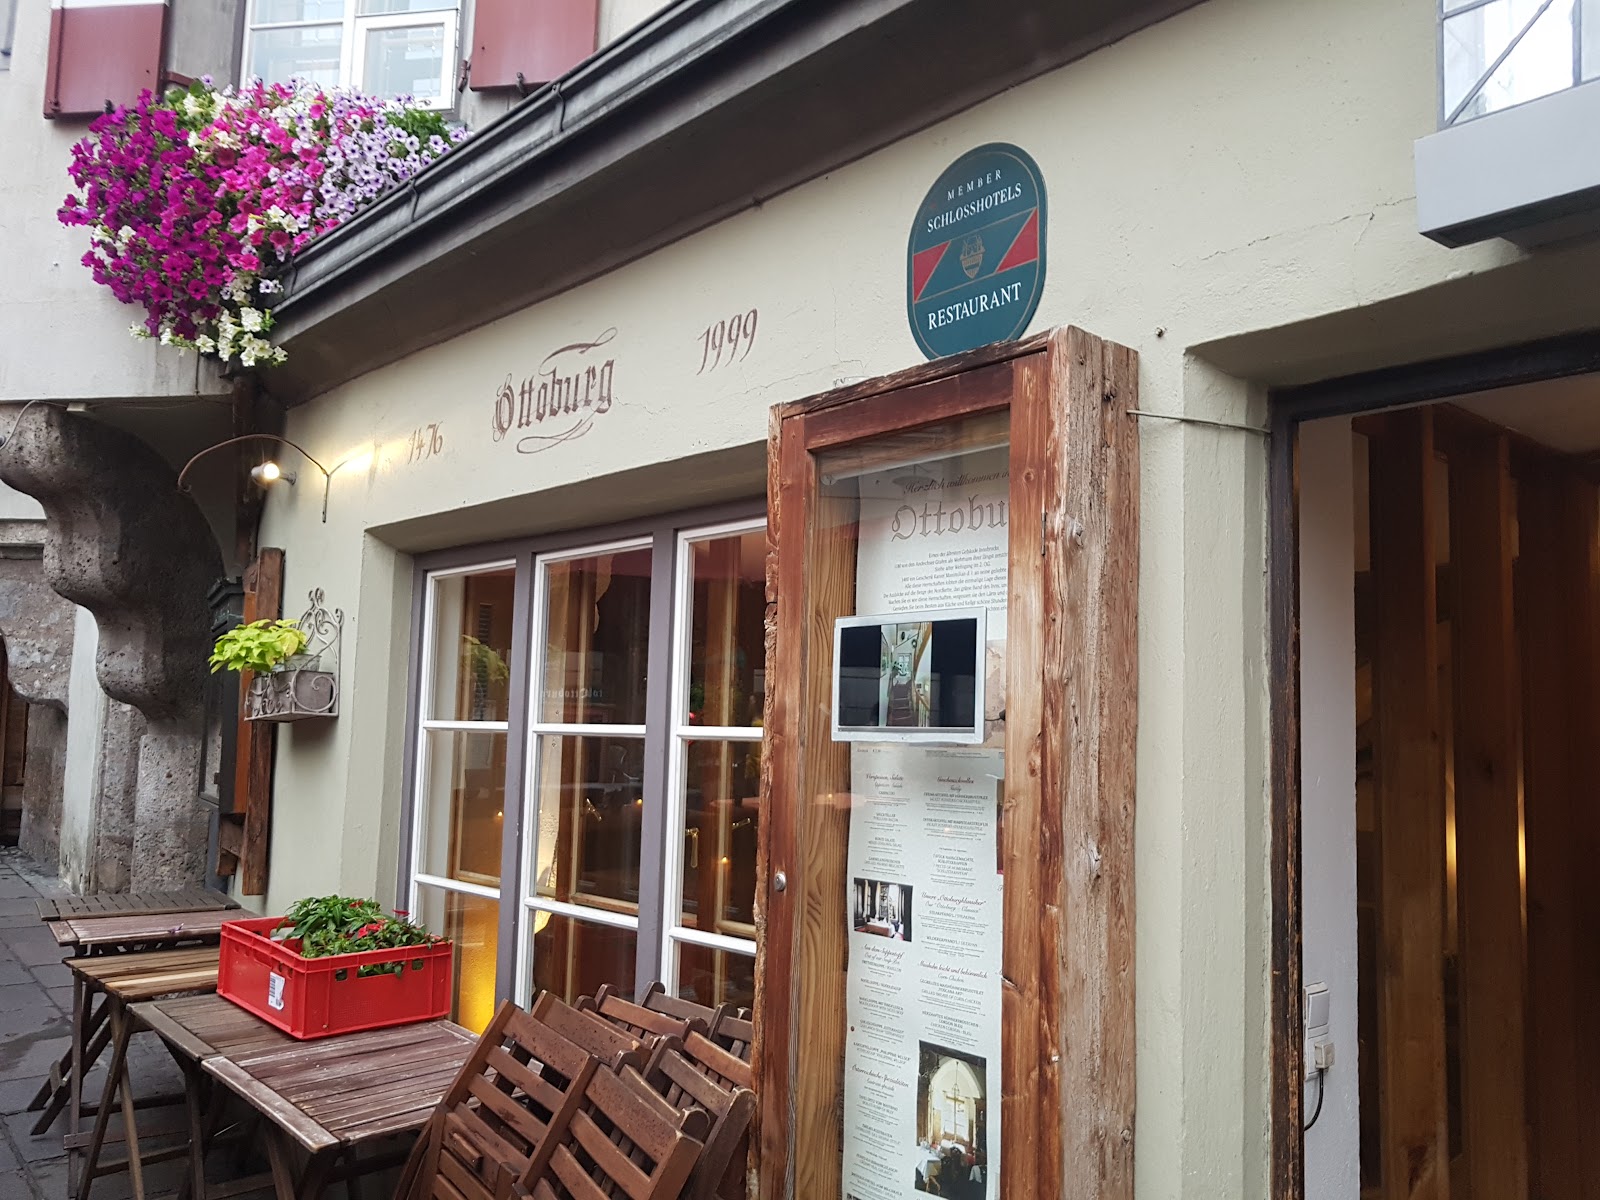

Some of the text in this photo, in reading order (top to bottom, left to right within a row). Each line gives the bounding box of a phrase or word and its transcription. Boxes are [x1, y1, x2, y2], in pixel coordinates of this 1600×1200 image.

[927, 182, 1022, 233] SCHLOSSHOTELS
[947, 169, 1002, 201] MEMBER
[928, 281, 1022, 330] RESTAURANT
[696, 307, 759, 376] 1999
[492, 350, 617, 446] Ottoburg
[407, 421, 445, 465] 1476
[891, 494, 1009, 542] Ottobu
